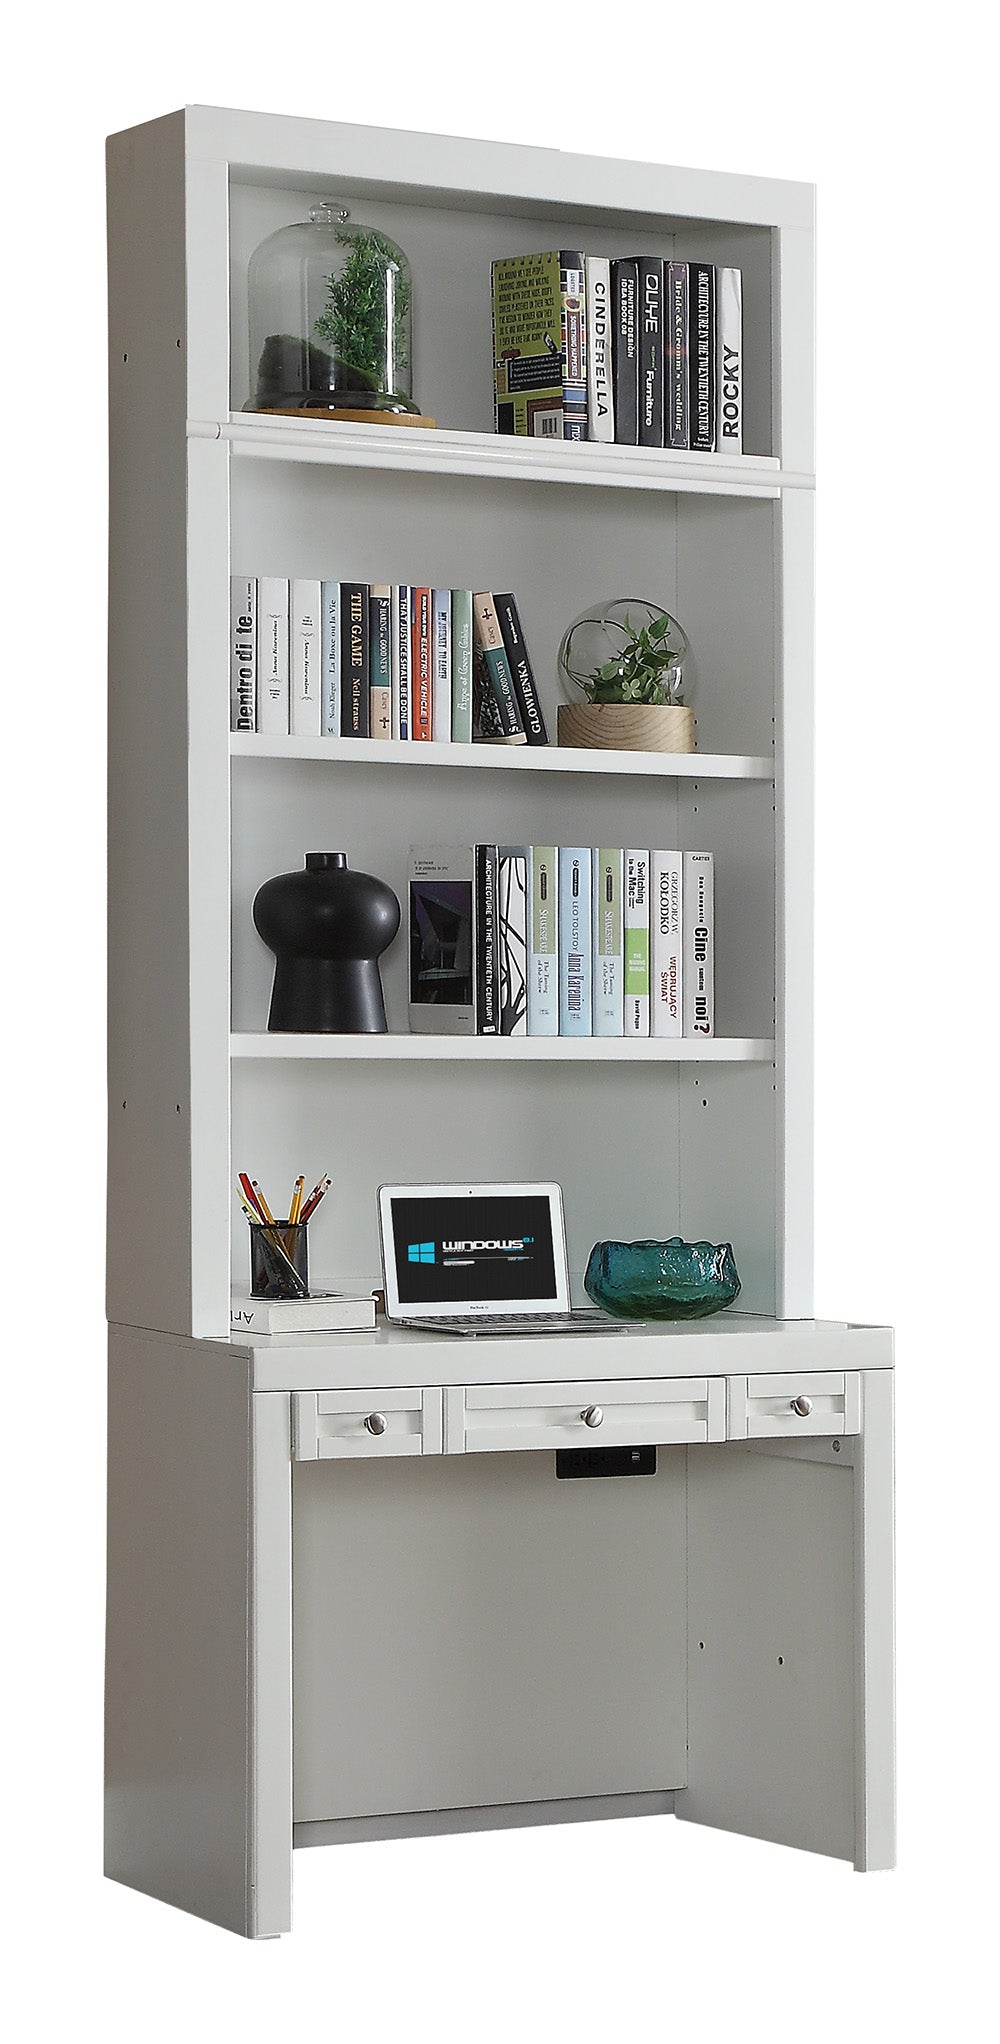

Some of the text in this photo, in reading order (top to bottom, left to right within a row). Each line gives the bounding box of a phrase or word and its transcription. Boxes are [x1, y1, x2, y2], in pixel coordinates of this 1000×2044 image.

[675, 314, 682, 325] &
[594, 282, 608, 418] CINDERELLA
[698, 340, 709, 355] THE
[722, 344, 739, 438] ROCKY
[698, 400, 709, 436] CENTURY
[351, 593, 362, 667] THE GAME
[236, 616, 253, 730] Dentro di te
[400, 687, 407, 698] BE
[636, 862, 645, 904] Switching
[660, 872, 669, 935] KOŁODKO
[485, 918, 492, 927] IN
[695, 927, 707, 962] Cine
[568, 953, 584, 973] Anna
[568, 976, 584, 1011] Karenina
[661, 972, 669, 1003] ŚWIAT
[442, 1240, 524, 1250] WINDOWS
